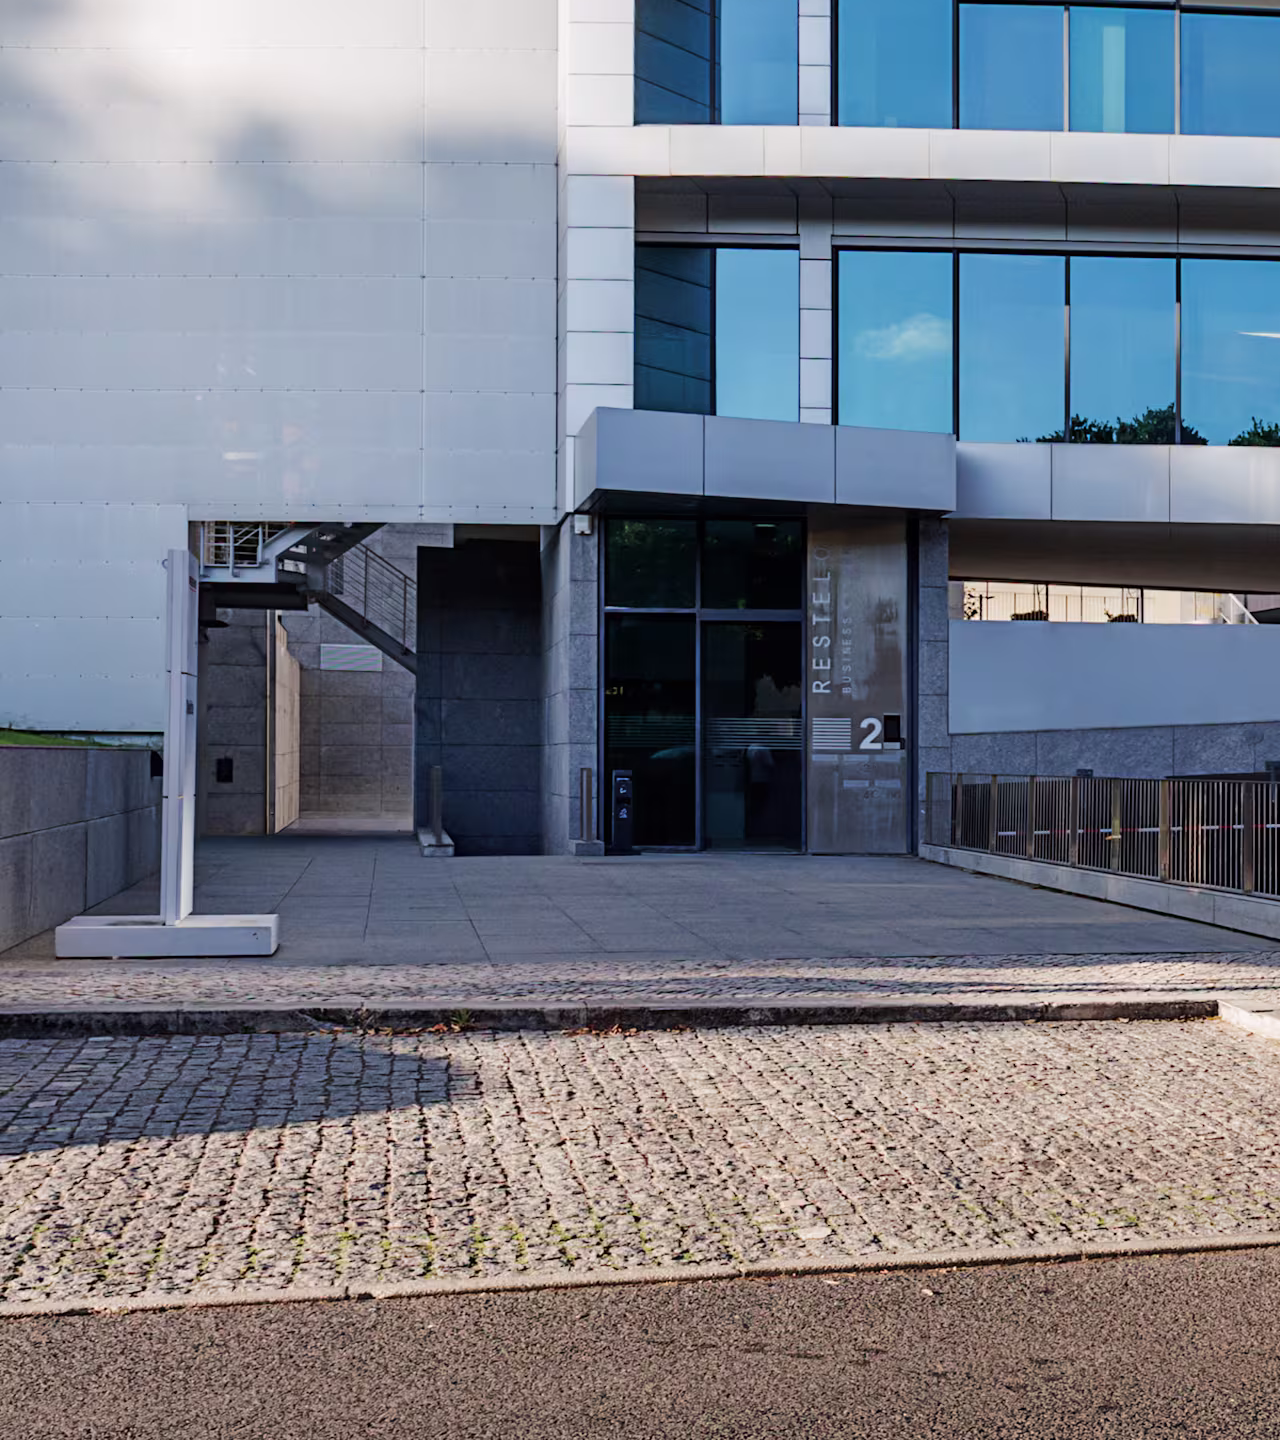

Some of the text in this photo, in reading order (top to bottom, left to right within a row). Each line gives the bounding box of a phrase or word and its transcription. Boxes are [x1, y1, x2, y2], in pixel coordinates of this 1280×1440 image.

[811, 546, 832, 694] RESTELO
[841, 617, 853, 694] BUSINESS
[859, 717, 883, 750] 2
